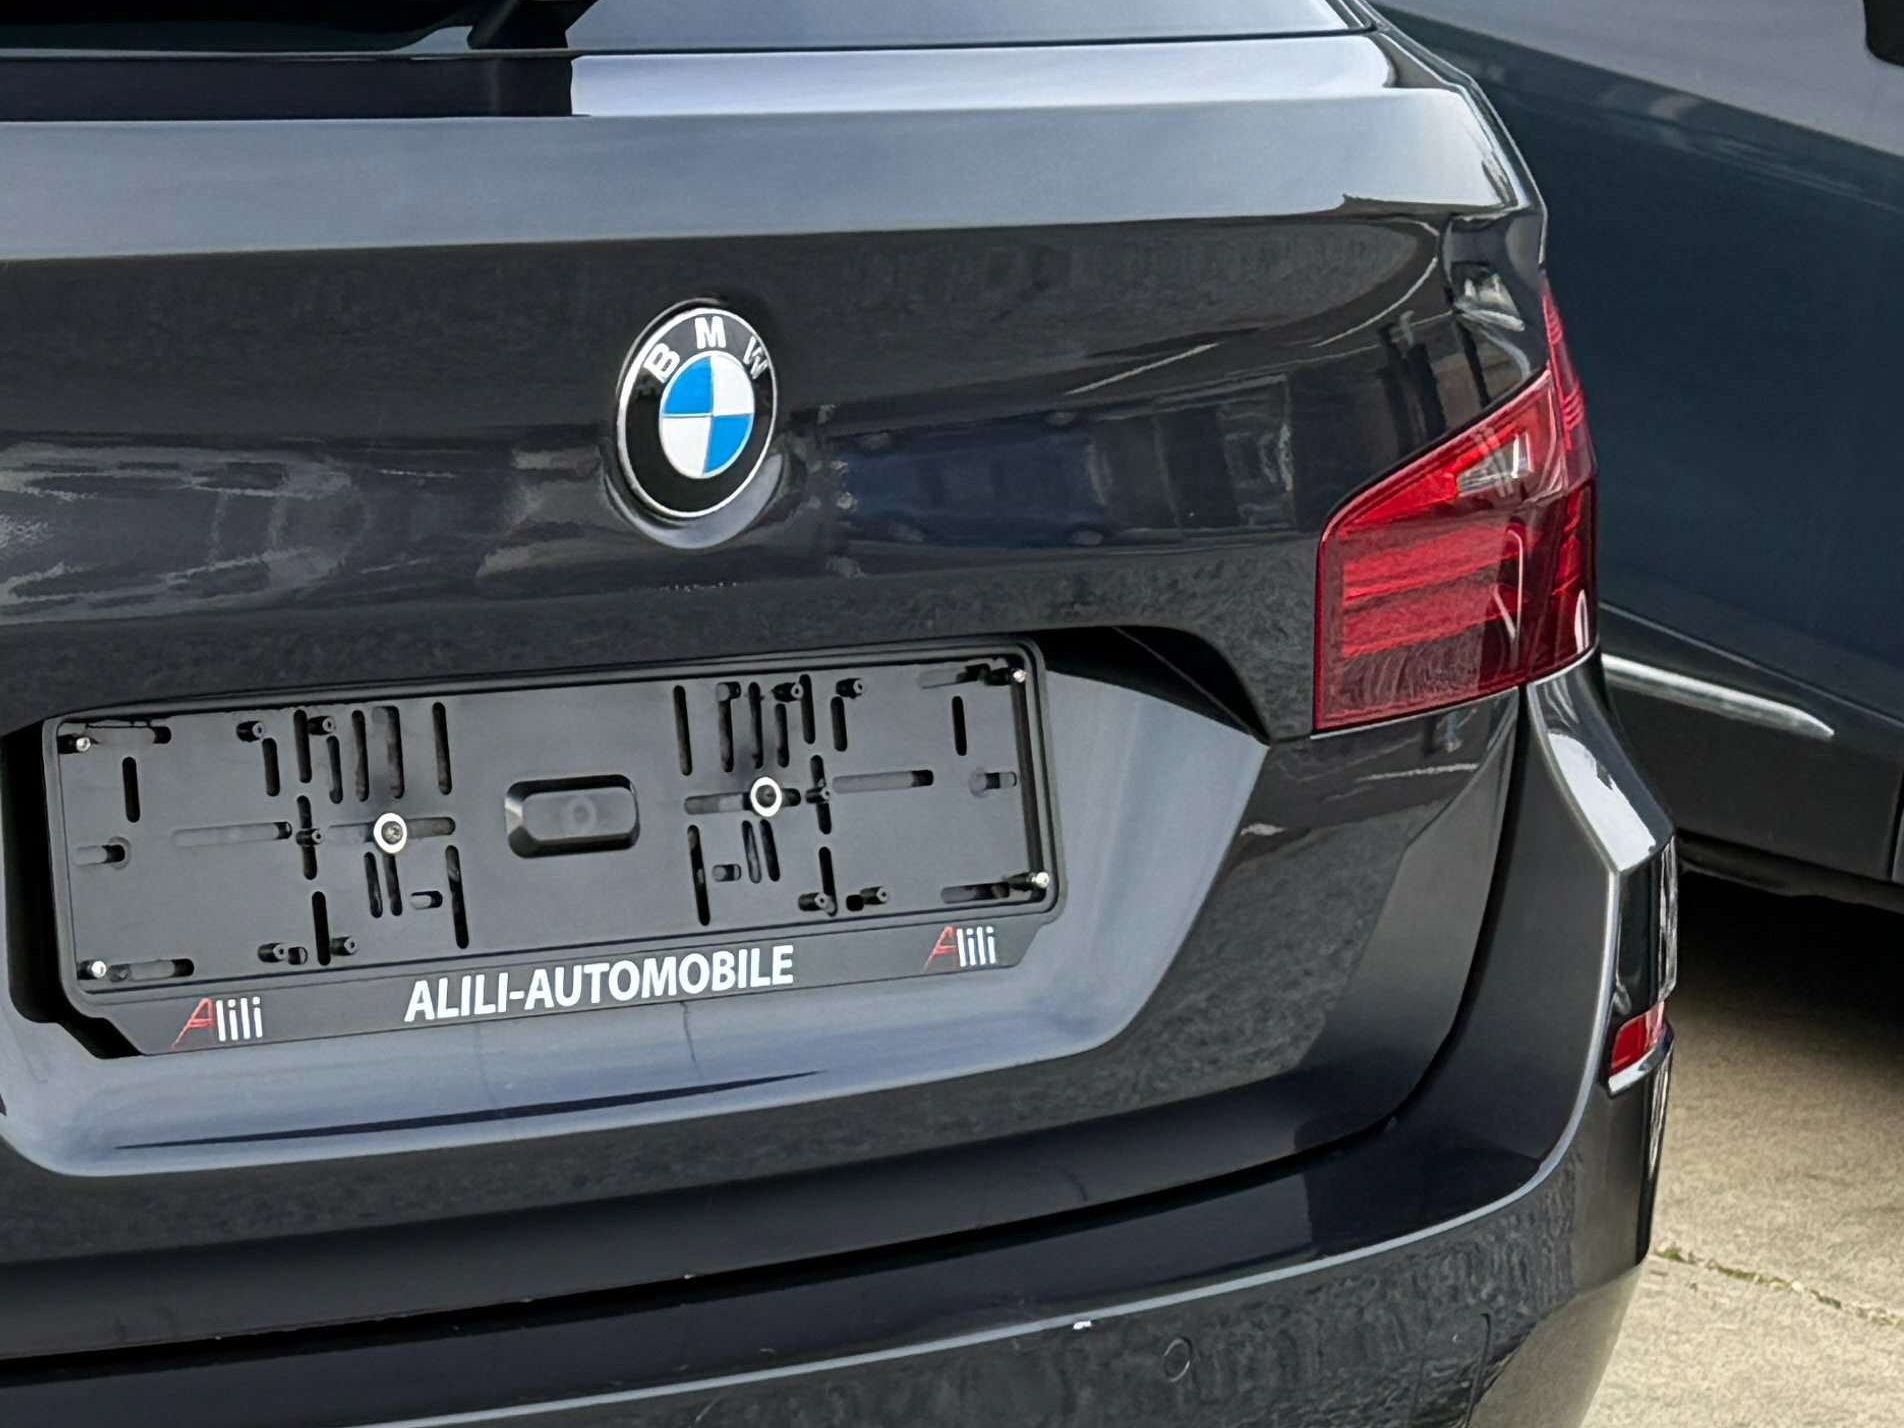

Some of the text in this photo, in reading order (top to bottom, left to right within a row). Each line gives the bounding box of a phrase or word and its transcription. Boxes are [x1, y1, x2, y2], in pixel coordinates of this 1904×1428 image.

[642, 315, 770, 384] BMW
[171, 924, 997, 1050] Alili ALILI-AUTOMOBILE Alili
